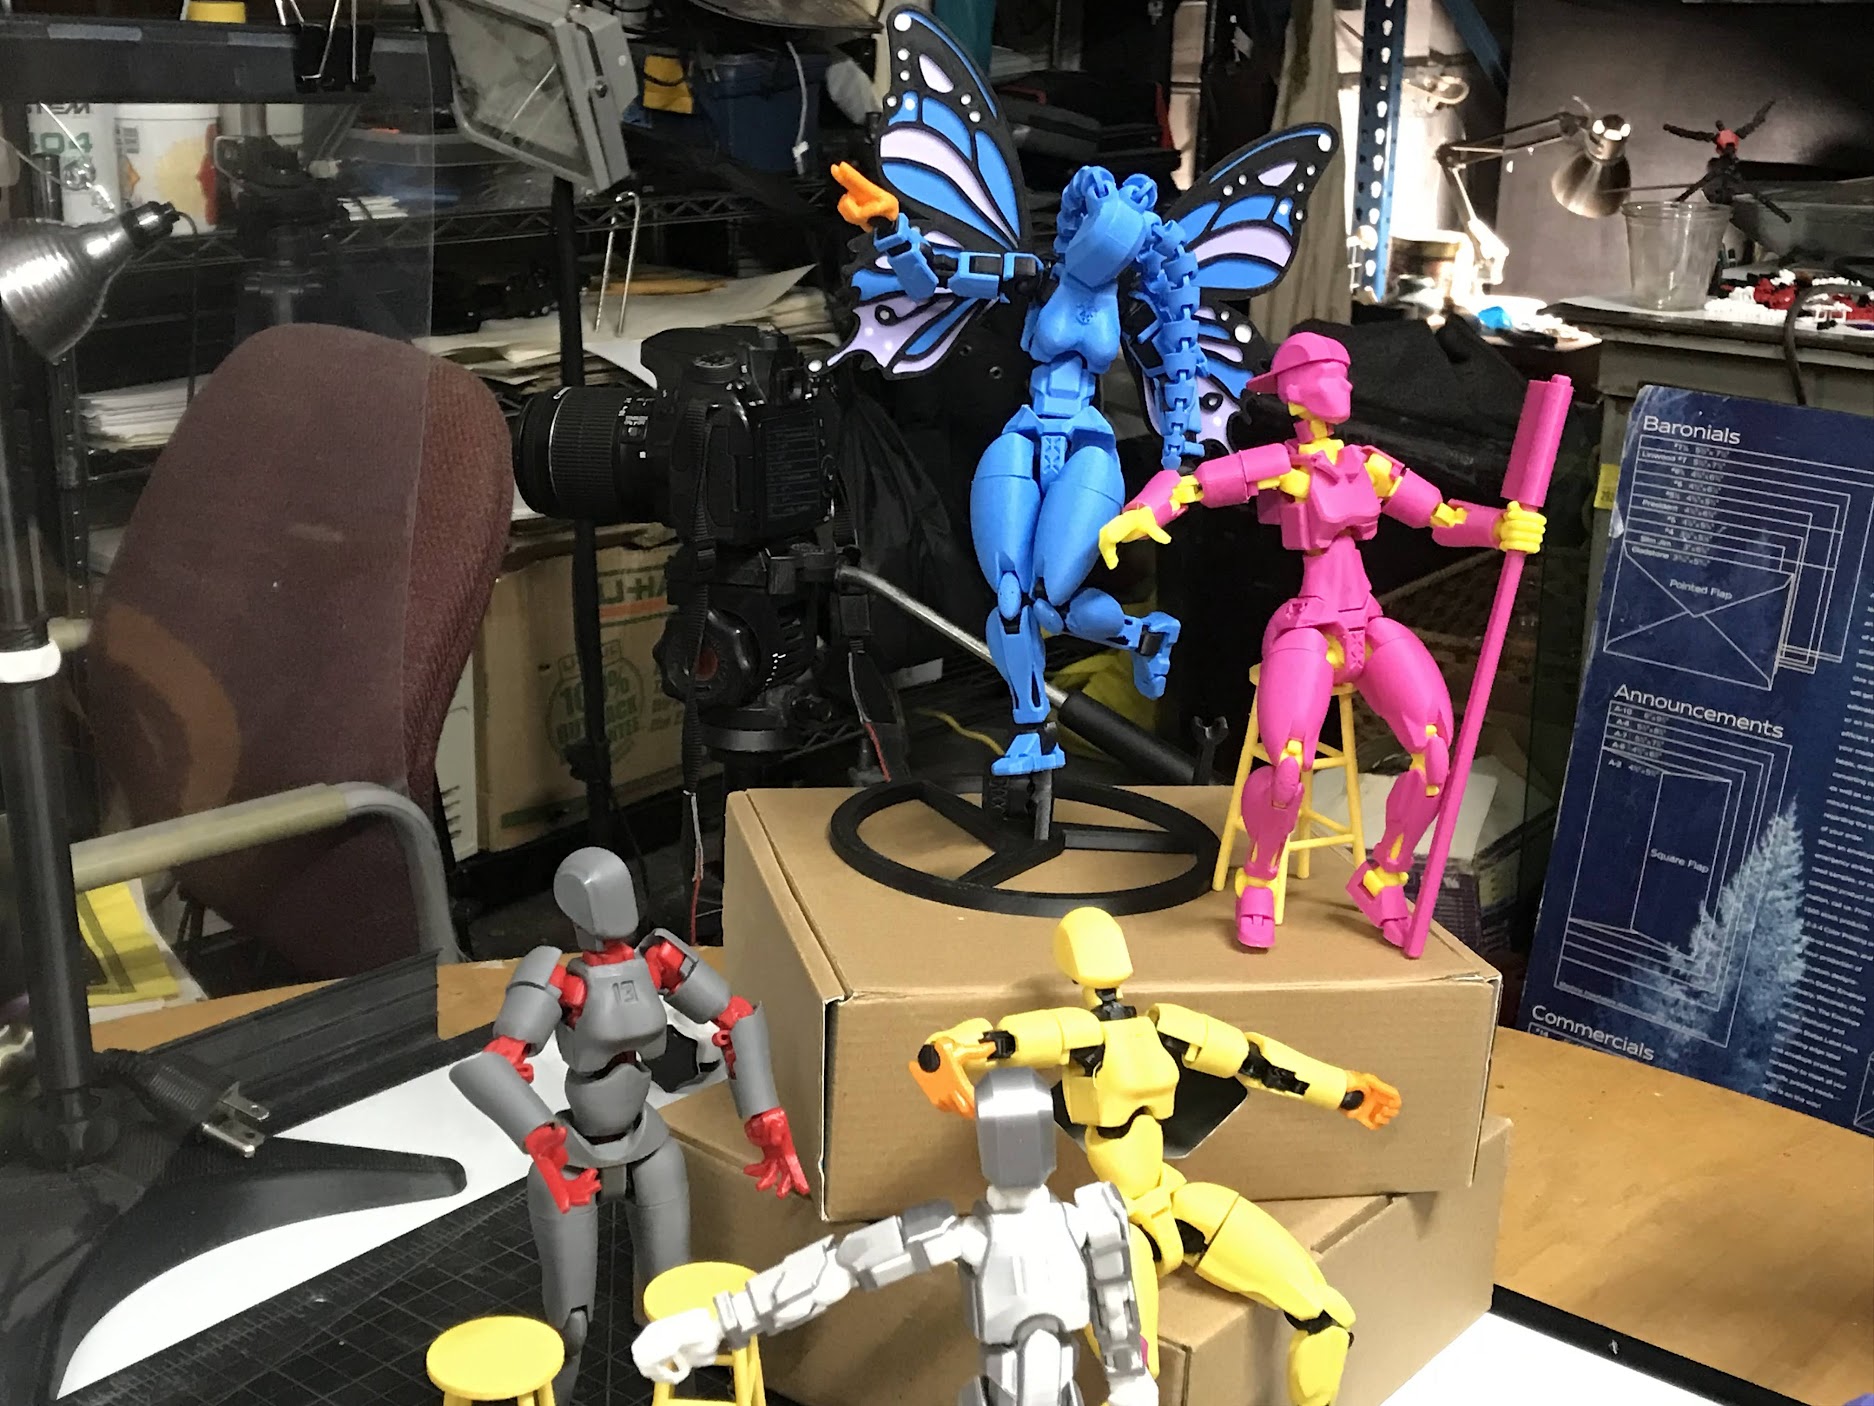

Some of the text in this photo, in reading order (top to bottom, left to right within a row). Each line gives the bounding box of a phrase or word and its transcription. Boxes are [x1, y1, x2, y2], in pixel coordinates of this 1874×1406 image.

[1642, 415, 1741, 445] Baronials
[1669, 578, 1733, 600] Pointed Flap
[1614, 684, 1784, 739] Announcements
[1650, 848, 1709, 873] Square Flap
[1532, 1004, 1655, 1061] Commercials
